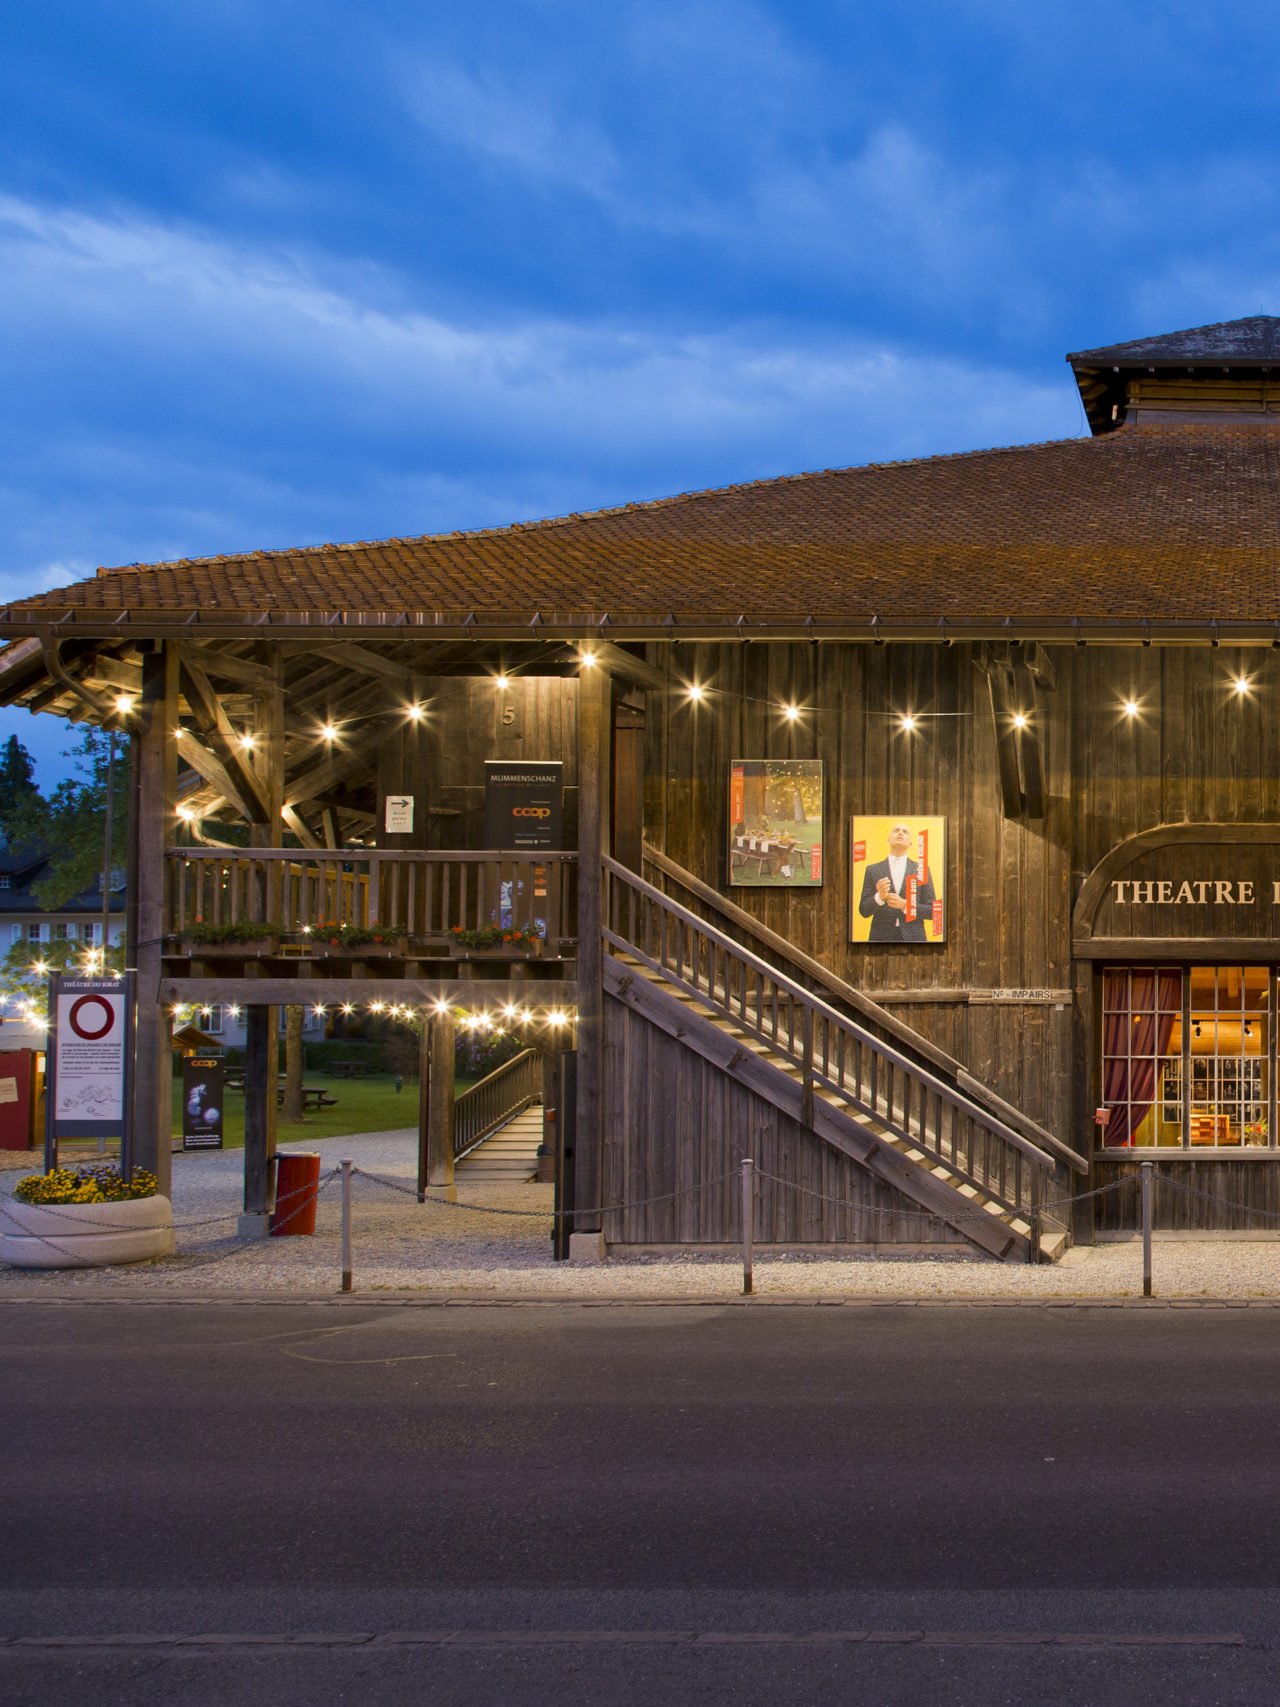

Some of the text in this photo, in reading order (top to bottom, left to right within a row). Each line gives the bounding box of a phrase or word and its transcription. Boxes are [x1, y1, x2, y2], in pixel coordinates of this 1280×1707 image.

[502, 705, 515, 725] 5
[512, 807, 551, 819] coop
[1111, 880, 1256, 905] THEATRE
[911, 908, 917, 917] 20
[1012, 990, 1050, 999] IMPAIRS
[191, 1060, 217, 1068] coop
